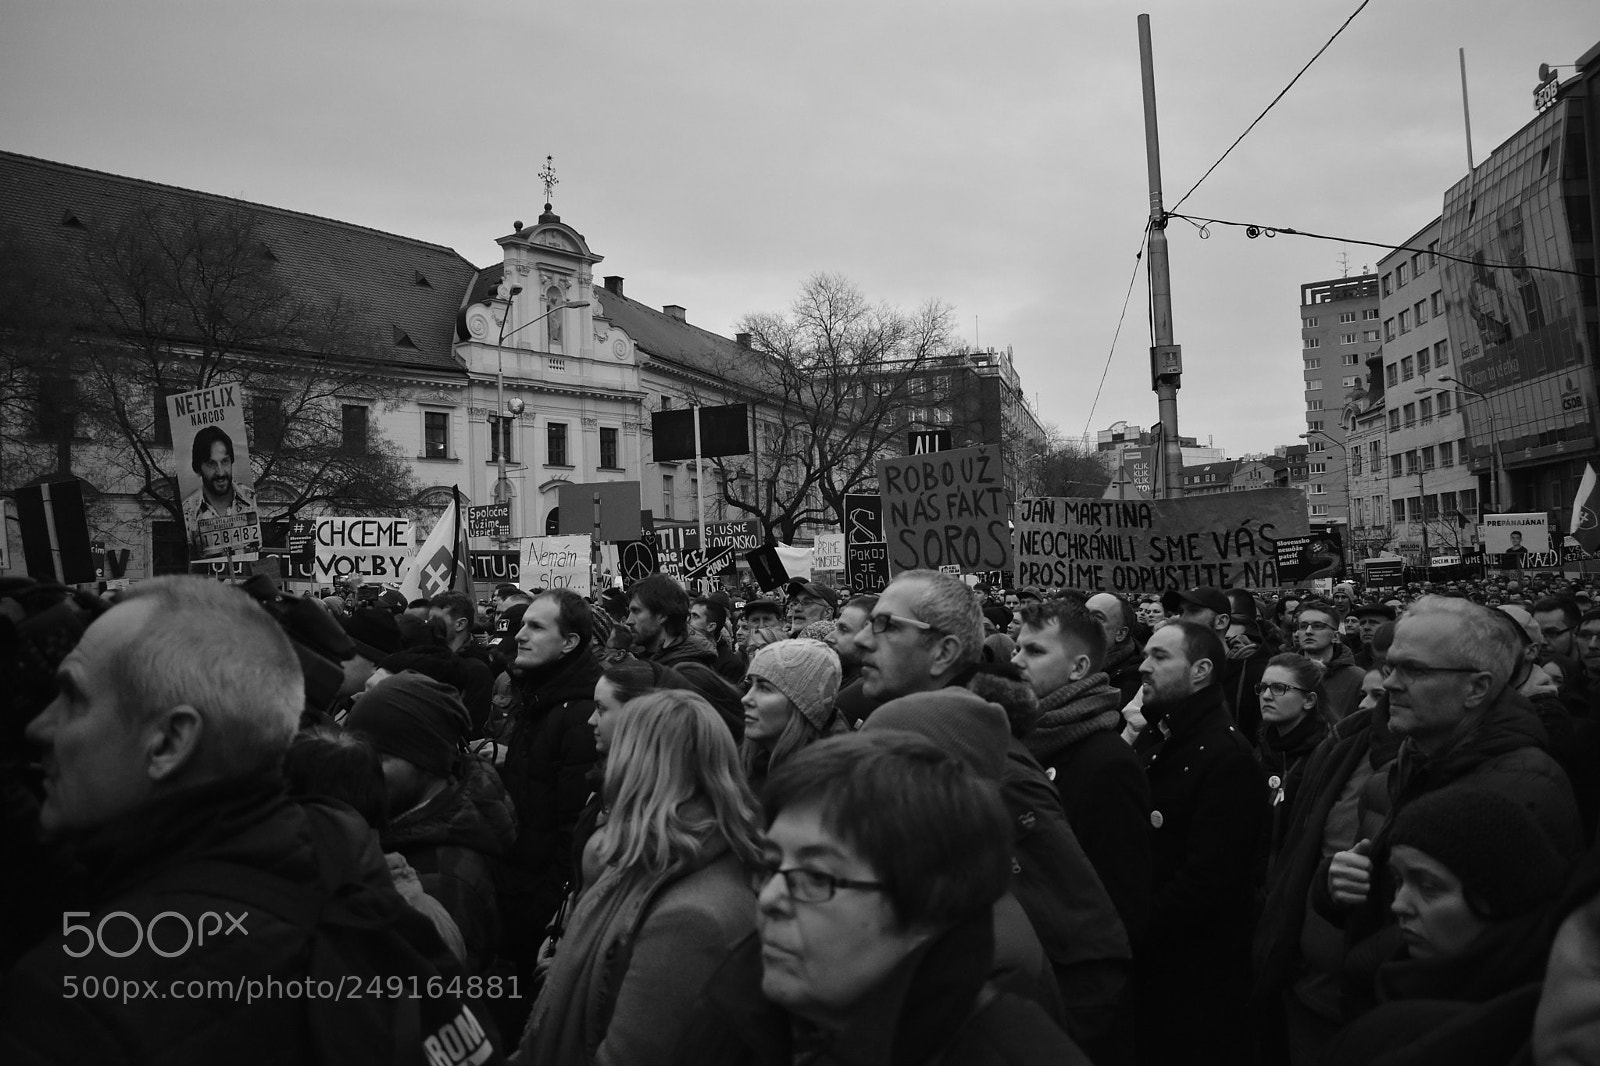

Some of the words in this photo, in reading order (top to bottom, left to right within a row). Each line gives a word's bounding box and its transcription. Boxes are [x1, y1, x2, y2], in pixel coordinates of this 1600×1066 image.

[175, 386, 235, 417] NETFLIX
[191, 408, 225, 426] NARCOS
[885, 461, 954, 494] ROBO
[962, 447, 995, 484] UŽ
[891, 491, 940, 528] NÁS
[1065, 502, 1153, 529] MARTINA
[204, 527, 259, 547] 128482
[317, 520, 408, 547] CHCEME
[705, 522, 747, 535] SLUŠNÉ
[1020, 527, 1135, 562] NEOCHRÁNILI
[1149, 533, 1202, 563] SME
[1211, 519, 1275, 560] VÁS
[527, 542, 577, 567] Nemám
[850, 548, 885, 560] POKOJ
[895, 521, 1007, 570] SOROS
[316, 554, 405, 578] VOĽBY
[684, 549, 709, 571] CEZ
[860, 562, 877, 572] JE
[855, 574, 886, 590] SILA
[1020, 558, 1105, 591] PROSÍME
[1113, 563, 1234, 592] ODPUSTITE
